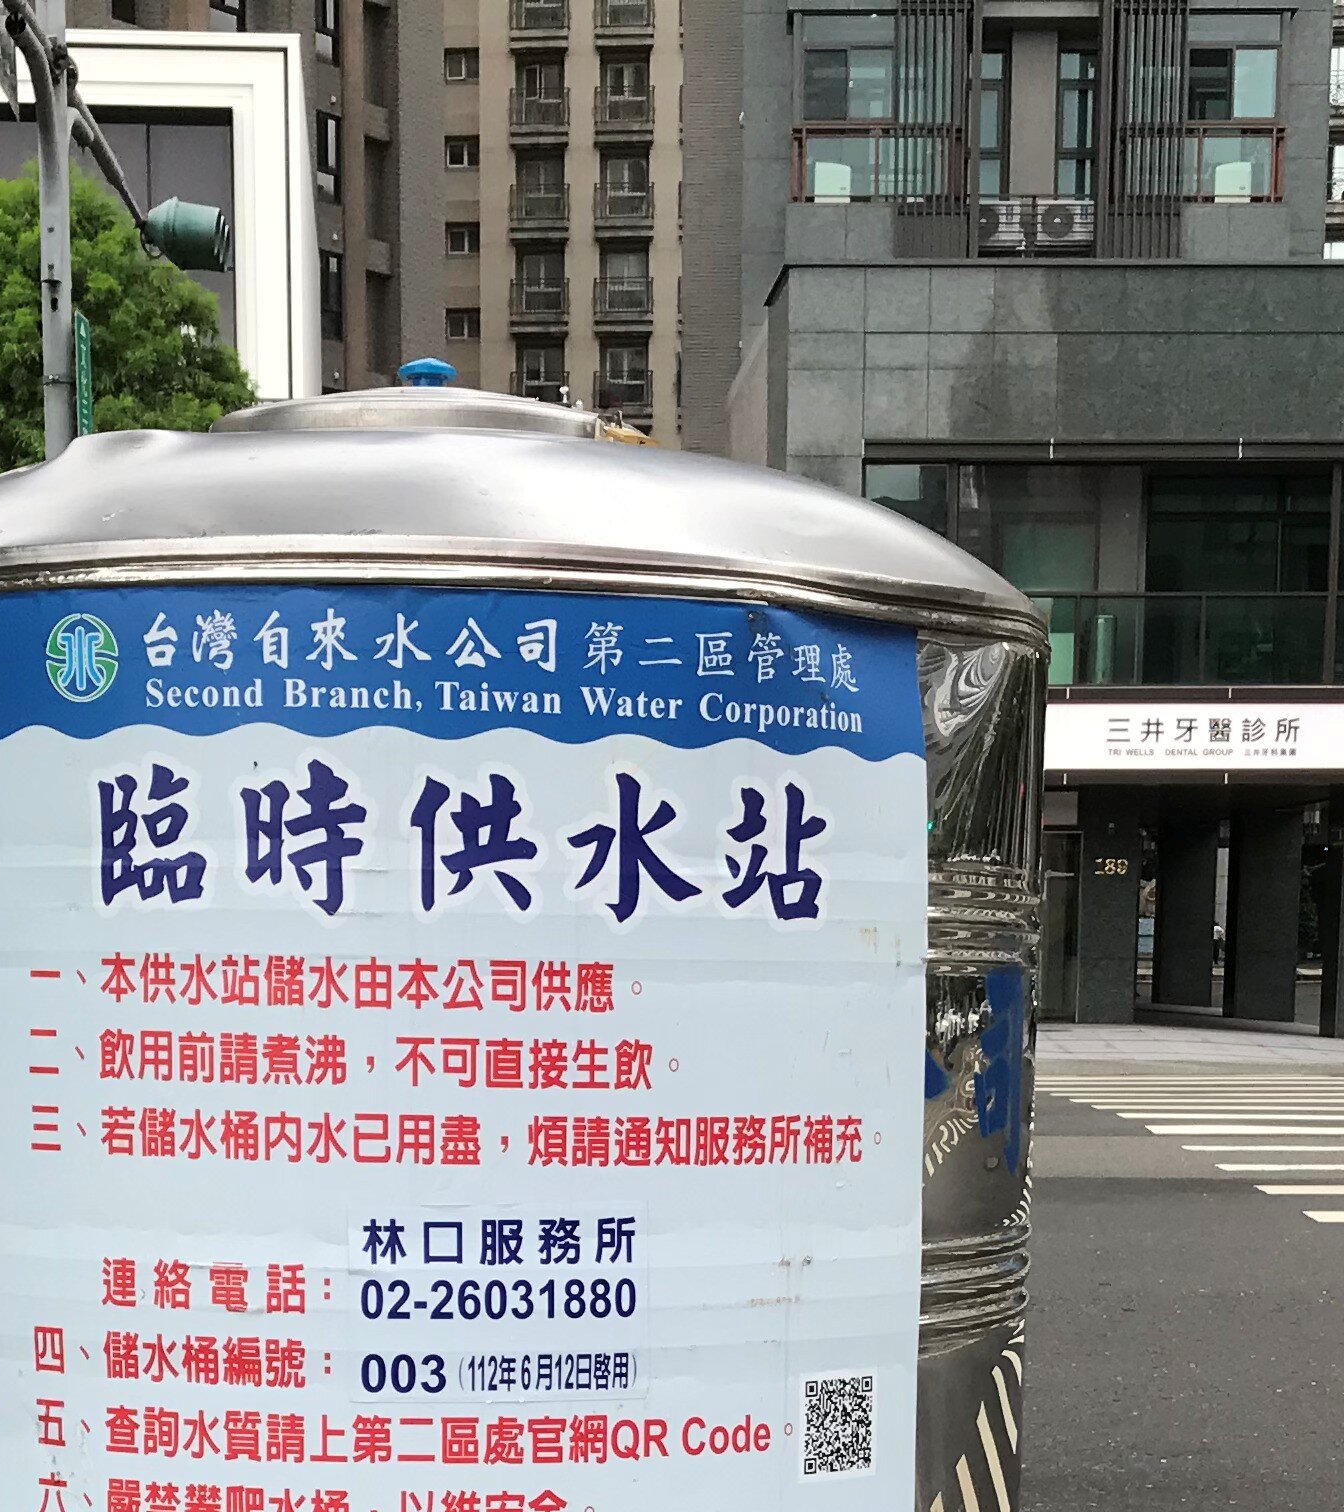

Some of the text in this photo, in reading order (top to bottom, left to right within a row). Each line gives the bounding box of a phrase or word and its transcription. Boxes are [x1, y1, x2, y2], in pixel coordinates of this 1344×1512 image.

[144, 609, 860, 694] 台灣自來水公司 第二區管理處
[146, 679, 863, 733] Second Branch, Taiwan Water Corporation
[1106, 717, 1301, 743] 三井牙醫診所
[1108, 748, 1122, 757] TRI
[1126, 748, 1155, 757] WELLS
[1164, 748, 1199, 757] DENTAL
[1202, 748, 1234, 757] GROUP
[98, 760, 827, 923] 臨時供水站
[362, 1216, 636, 1266] 林口服務所
[102, 1258, 333, 1313] 連絡電話：
[361, 1278, 636, 1321] 02-26031880
[361, 1353, 447, 1394] 003
